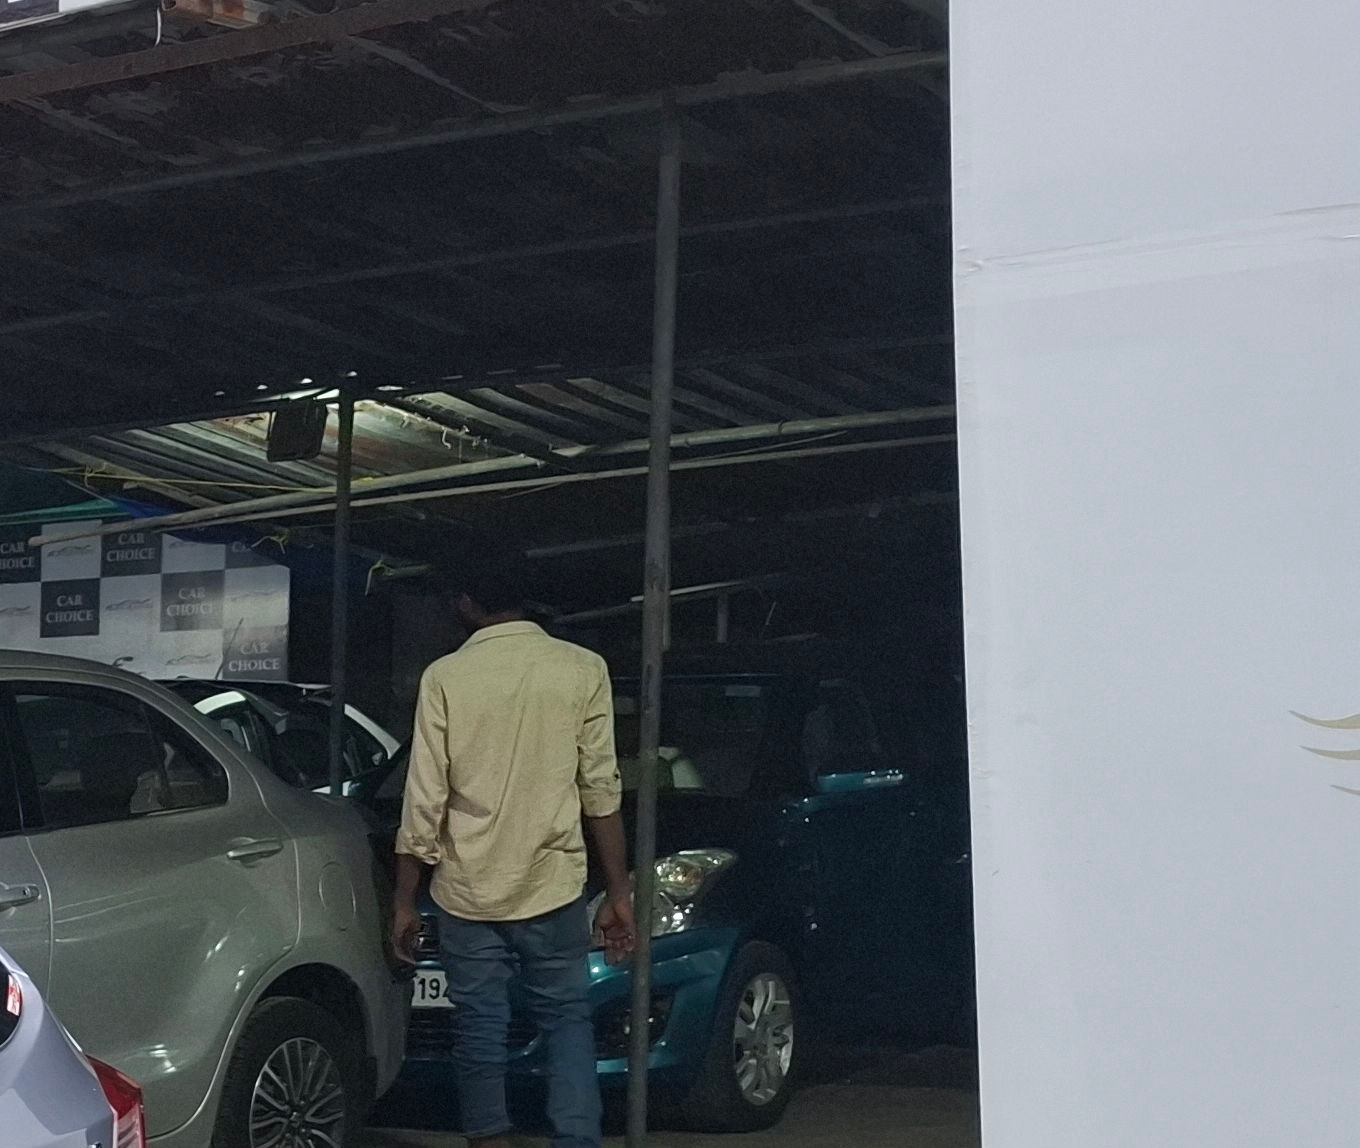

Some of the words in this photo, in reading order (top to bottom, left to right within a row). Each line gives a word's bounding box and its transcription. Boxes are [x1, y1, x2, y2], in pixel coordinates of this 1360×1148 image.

[118, 532, 145, 545] CAR
[0, 541, 25, 554] CAR
[106, 547, 156, 563] CHOICE
[56, 595, 83, 607] CAR
[46, 609, 94, 624] CHOICE
[229, 657, 280, 672] CHOICE
